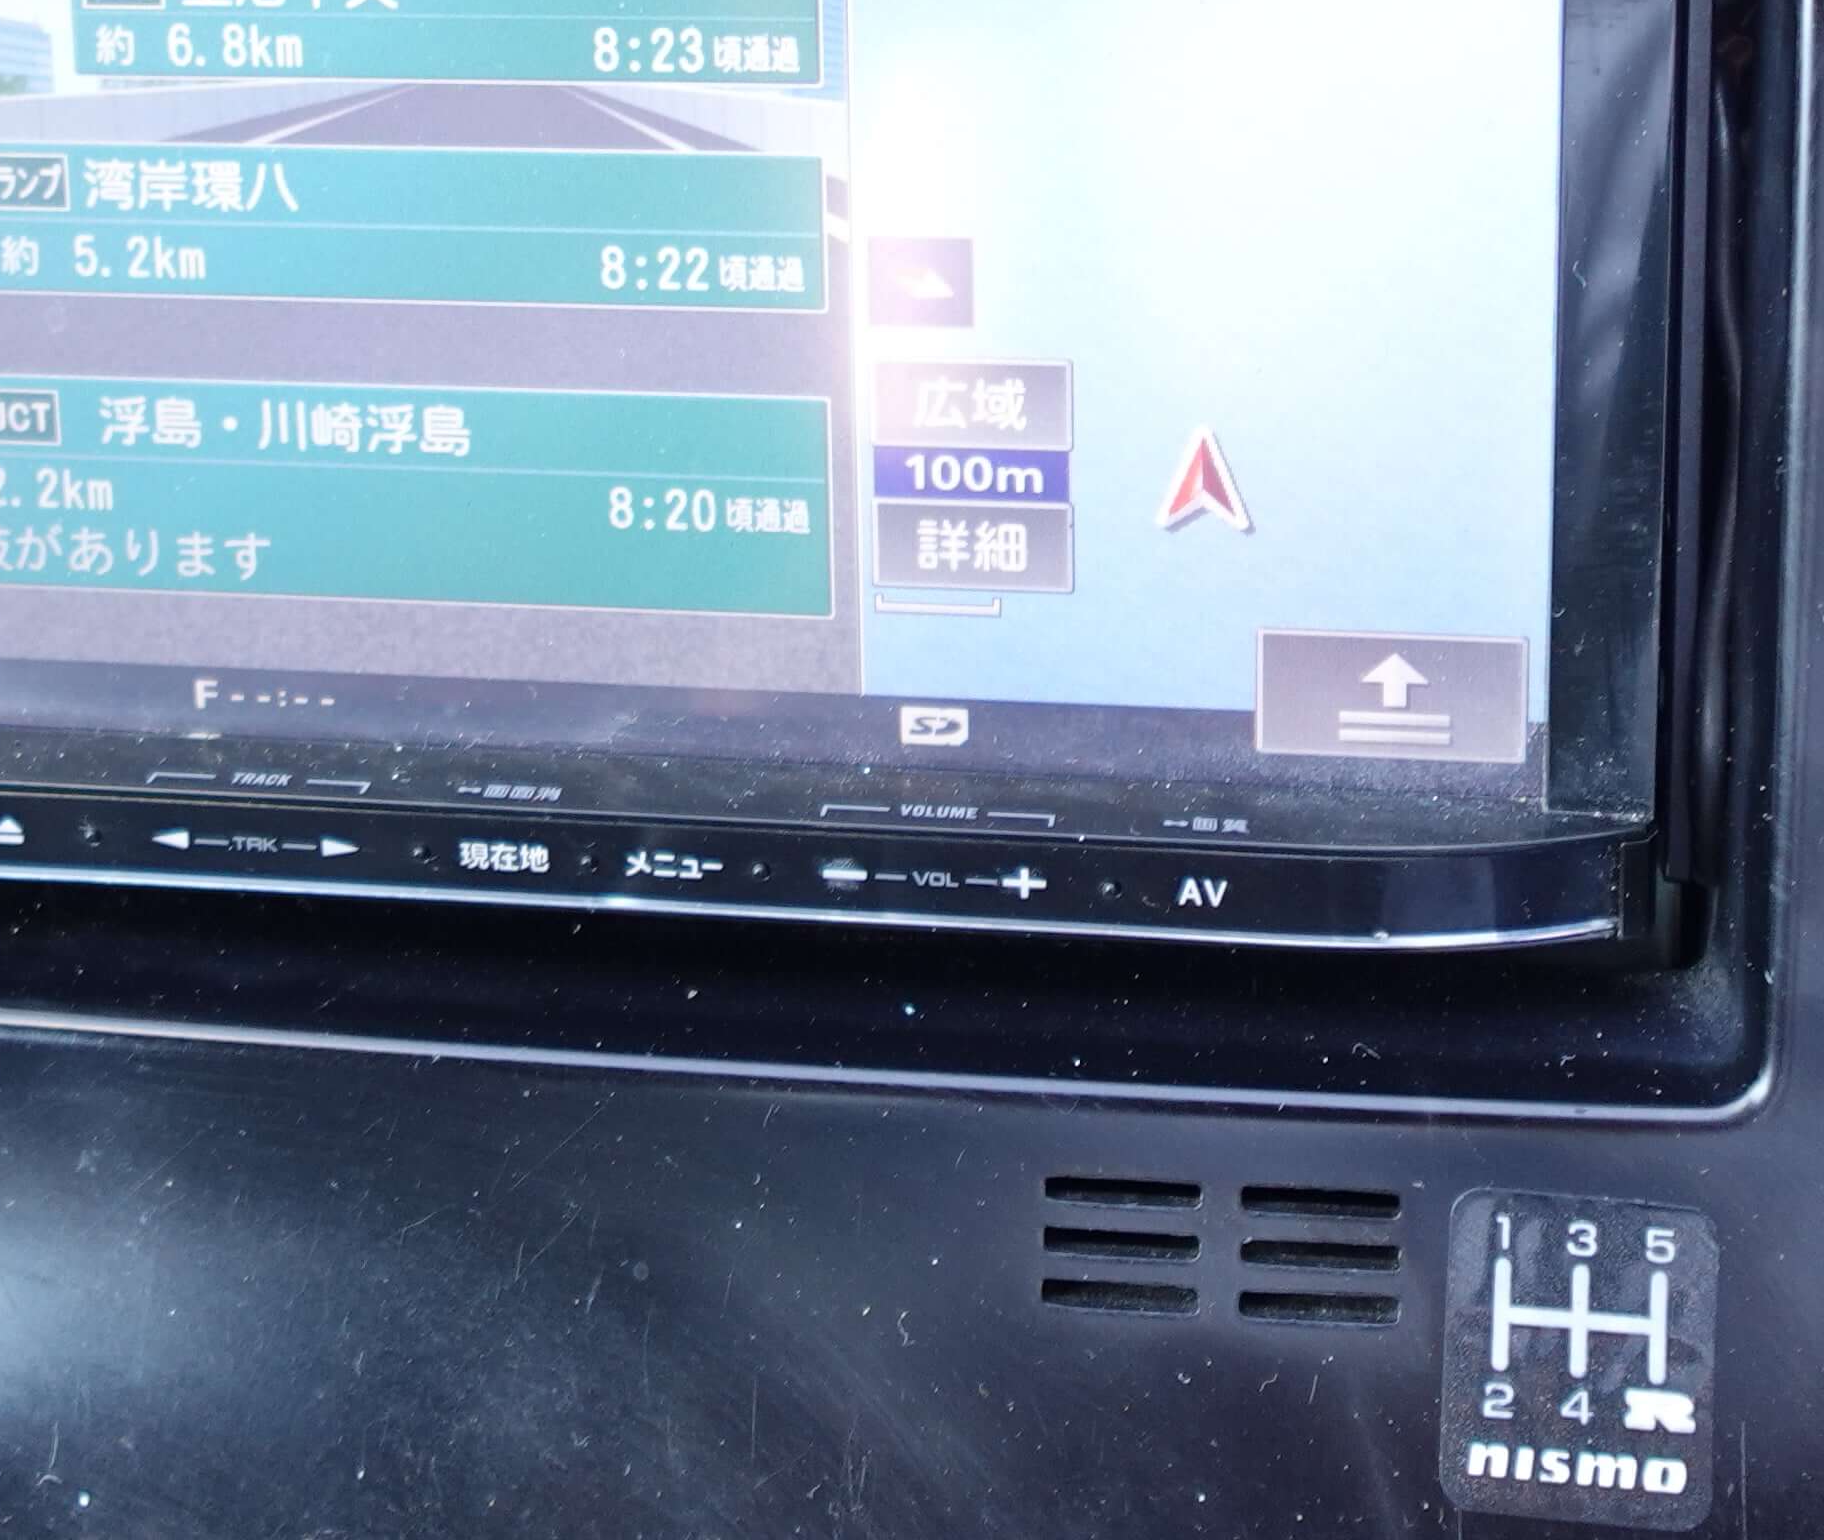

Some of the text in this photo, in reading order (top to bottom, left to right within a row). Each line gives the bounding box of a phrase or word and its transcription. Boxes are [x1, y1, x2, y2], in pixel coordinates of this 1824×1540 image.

[95, 26, 136, 67] 約
[167, 25, 304, 69] 6.8km
[593, 26, 705, 73] 8:23
[83, 158, 299, 212] 湾岸環八
[1, 238, 39, 276] 約
[74, 235, 206, 280] 5.2km
[600, 245, 710, 291] 8:22
[99, 394, 472, 458] 浮島・川崎浮島
[912, 378, 1028, 432] 広域
[905, 456, 1045, 495] 100m
[608, 486, 716, 532] 8:20
[916, 520, 1029, 574] 詳細
[232, 771, 293, 788] TRACK
[899, 802, 979, 821] VOLUME
[232, 836, 279, 853] TRK
[459, 840, 550, 876] 現在地
[625, 852, 725, 881] メニュー
[912, 870, 960, 889] VOL
[1179, 878, 1228, 908] AV
[1495, 1216, 1677, 1263] 1 3 5
[1483, 1383, 1696, 1434] 2 4 R
[1467, 1442, 1688, 1495] nismo
